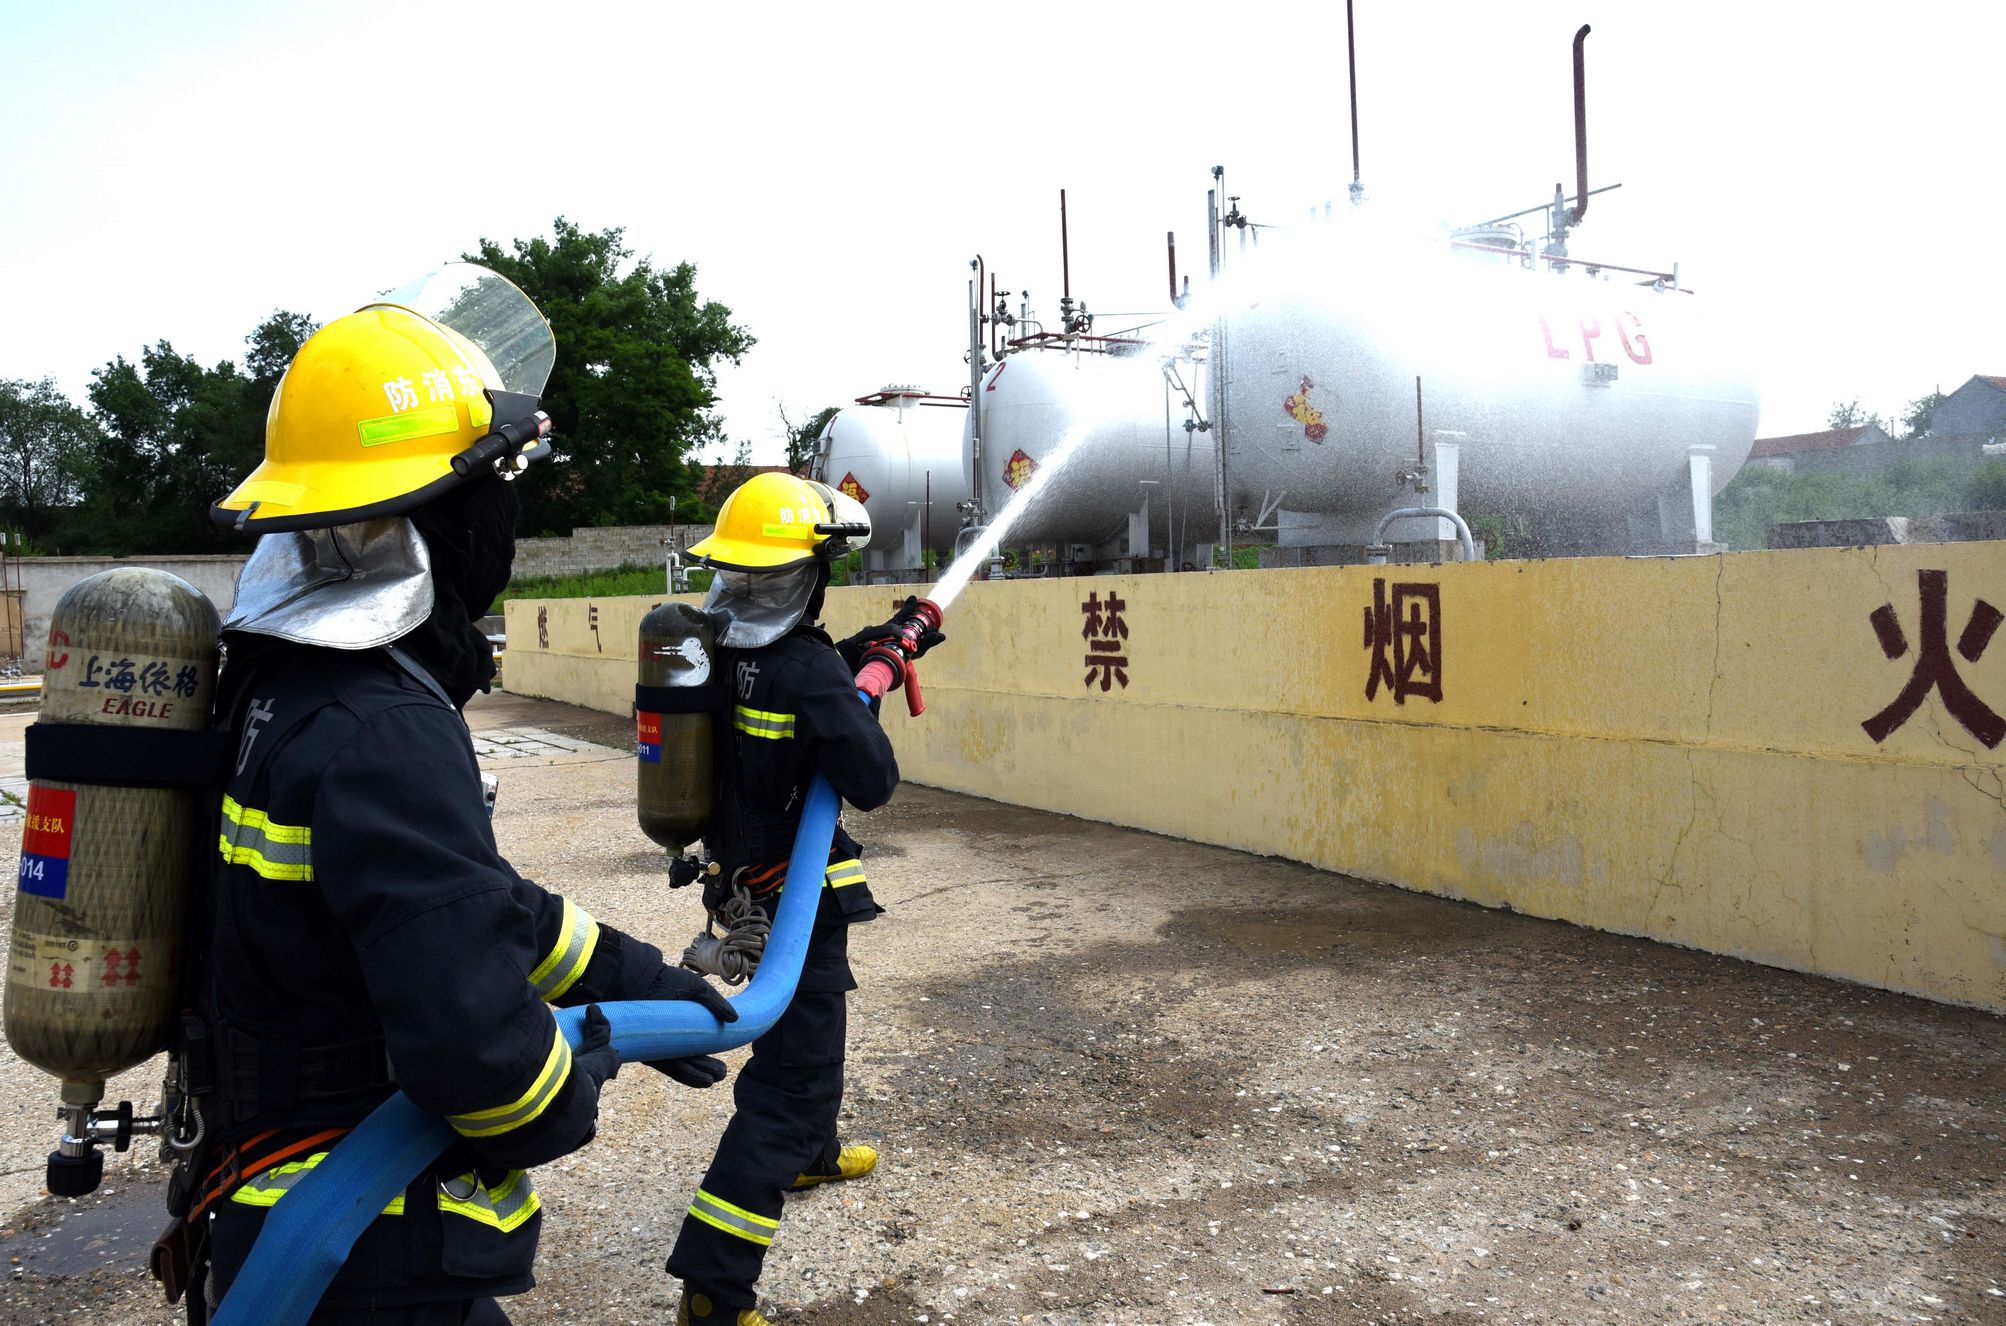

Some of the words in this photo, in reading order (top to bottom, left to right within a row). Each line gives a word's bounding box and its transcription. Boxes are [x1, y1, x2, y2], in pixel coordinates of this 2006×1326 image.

[986, 362, 1006, 392] 2
[737, 660, 760, 700] 防
[102, 697, 174, 719] EAGLE
